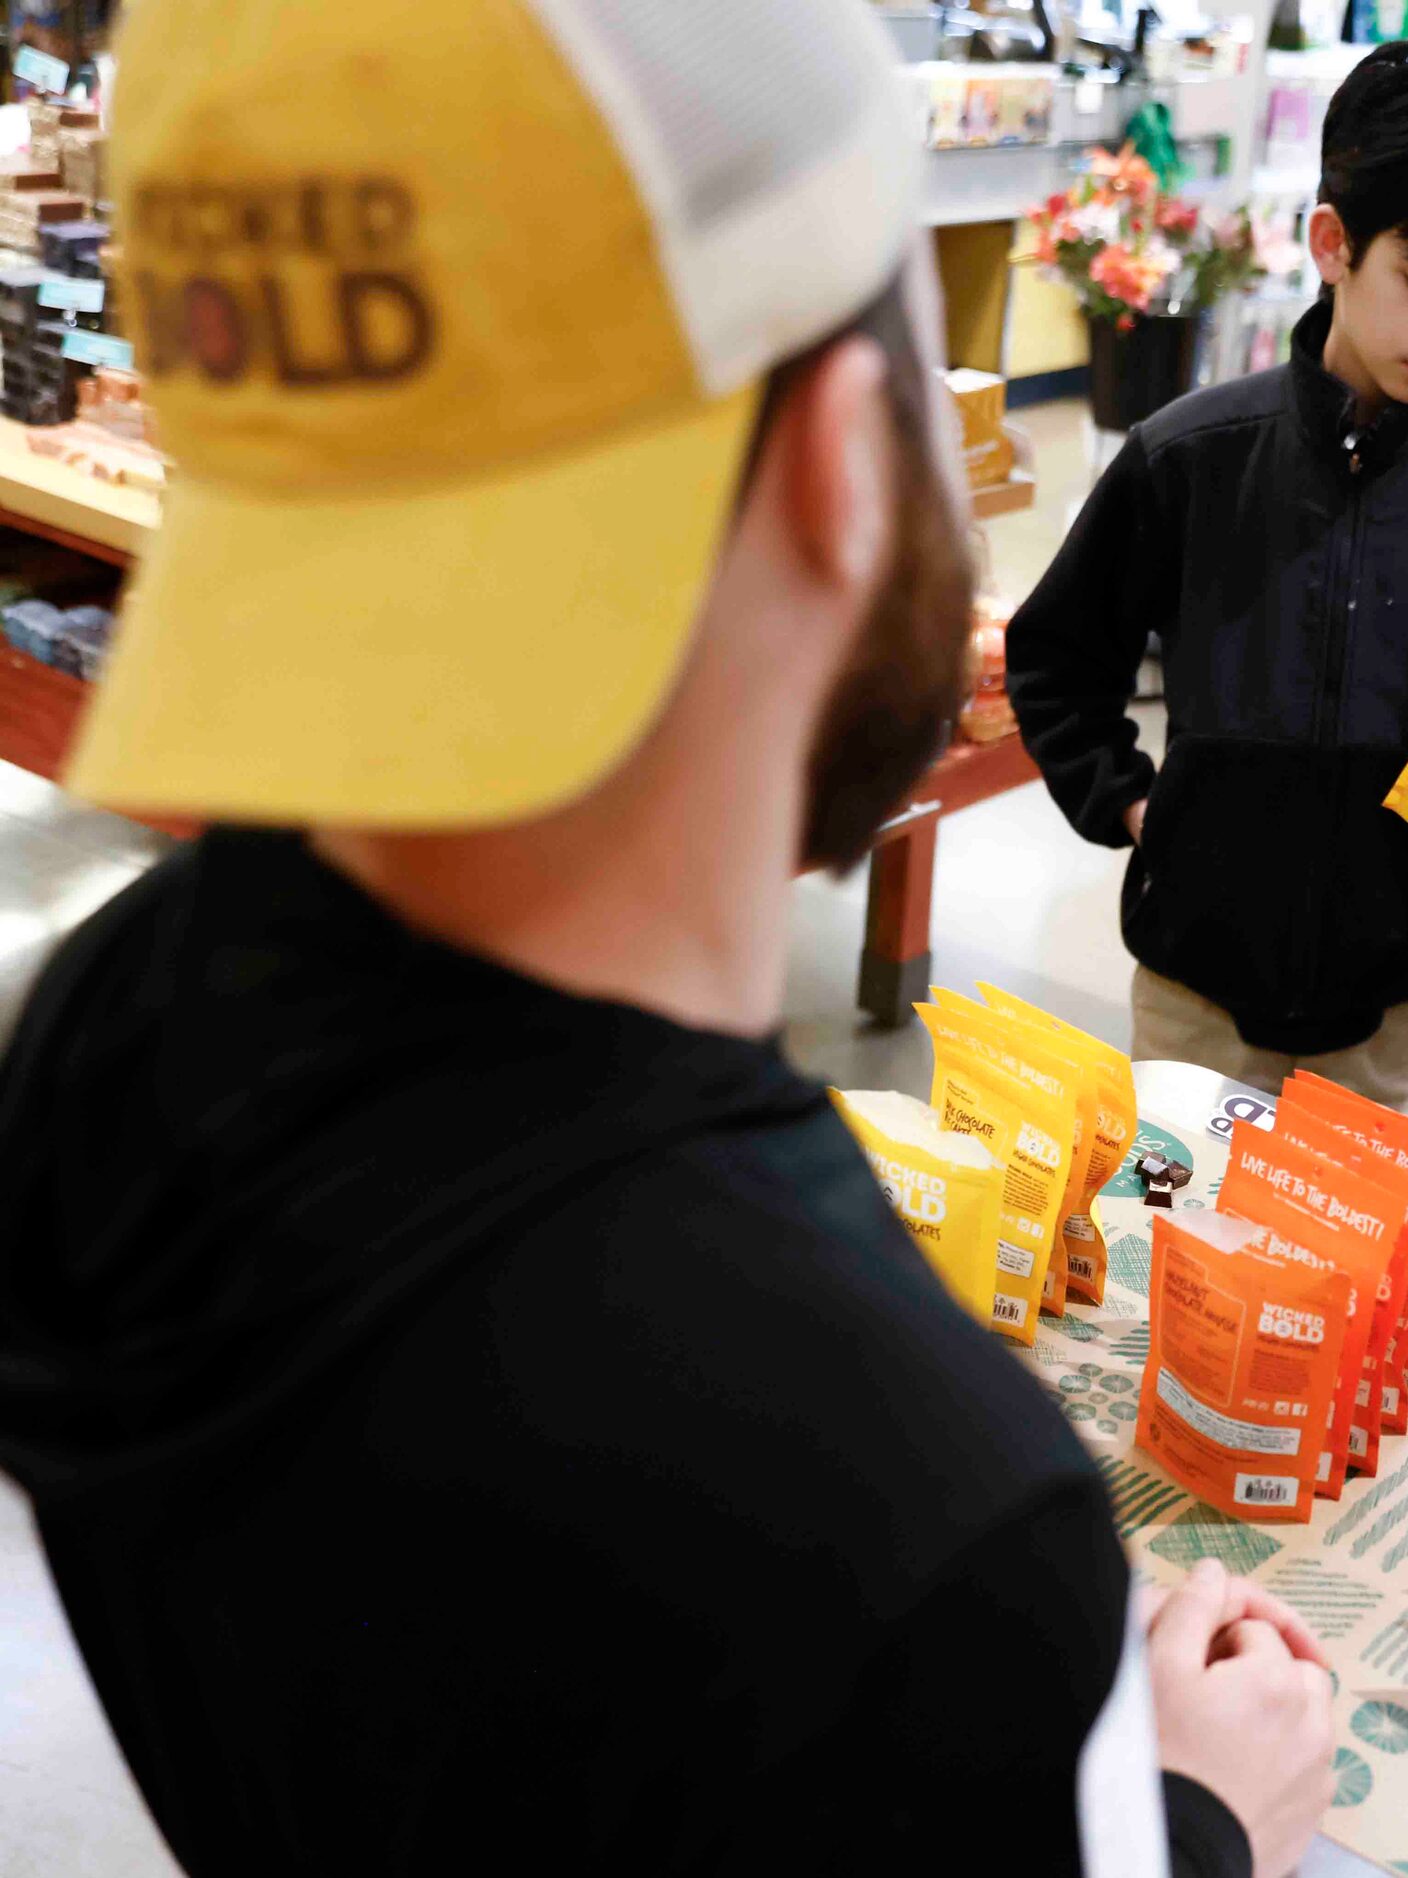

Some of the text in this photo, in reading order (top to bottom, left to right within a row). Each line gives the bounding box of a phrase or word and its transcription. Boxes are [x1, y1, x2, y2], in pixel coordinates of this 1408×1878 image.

[955, 1108, 996, 1140] CHOCOLATE
[1016, 1131, 1061, 1168] BOLD
[878, 1179, 948, 1224] OLD
[1239, 1151, 1268, 1179] LIVE
[1266, 1164, 1292, 1193] LIFE
[1291, 1175, 1307, 1197] TO
[1306, 1183, 1329, 1213] THE
[1326, 1195, 1386, 1242] BOLDEST!
[1257, 1312, 1325, 1344] BOLD
[1262, 1300, 1326, 1330] WICKED
